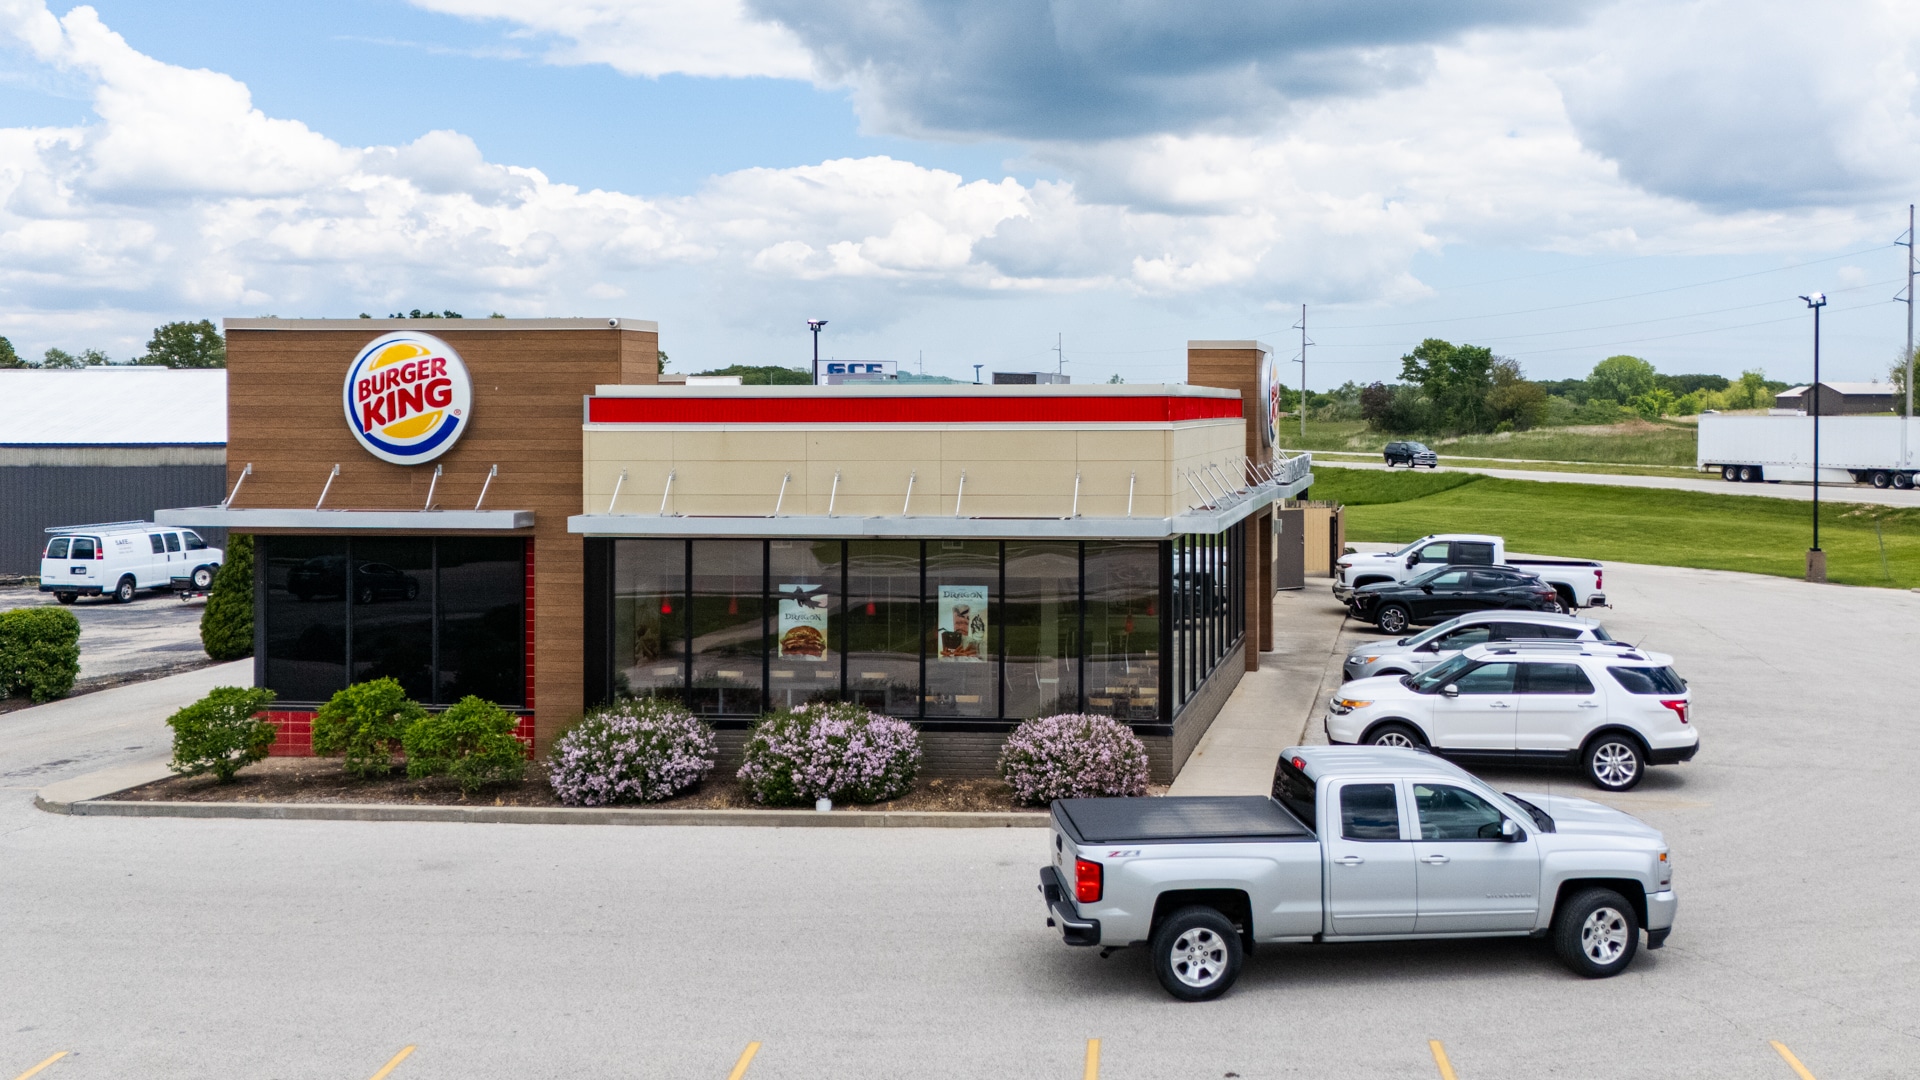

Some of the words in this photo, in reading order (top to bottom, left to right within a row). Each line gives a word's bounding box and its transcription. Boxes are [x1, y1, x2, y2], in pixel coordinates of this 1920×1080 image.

[358, 357, 447, 402] BURGER
[362, 378, 452, 433] KING
[943, 591, 984, 600] DRAGON
[785, 613, 821, 621] DRAGON
